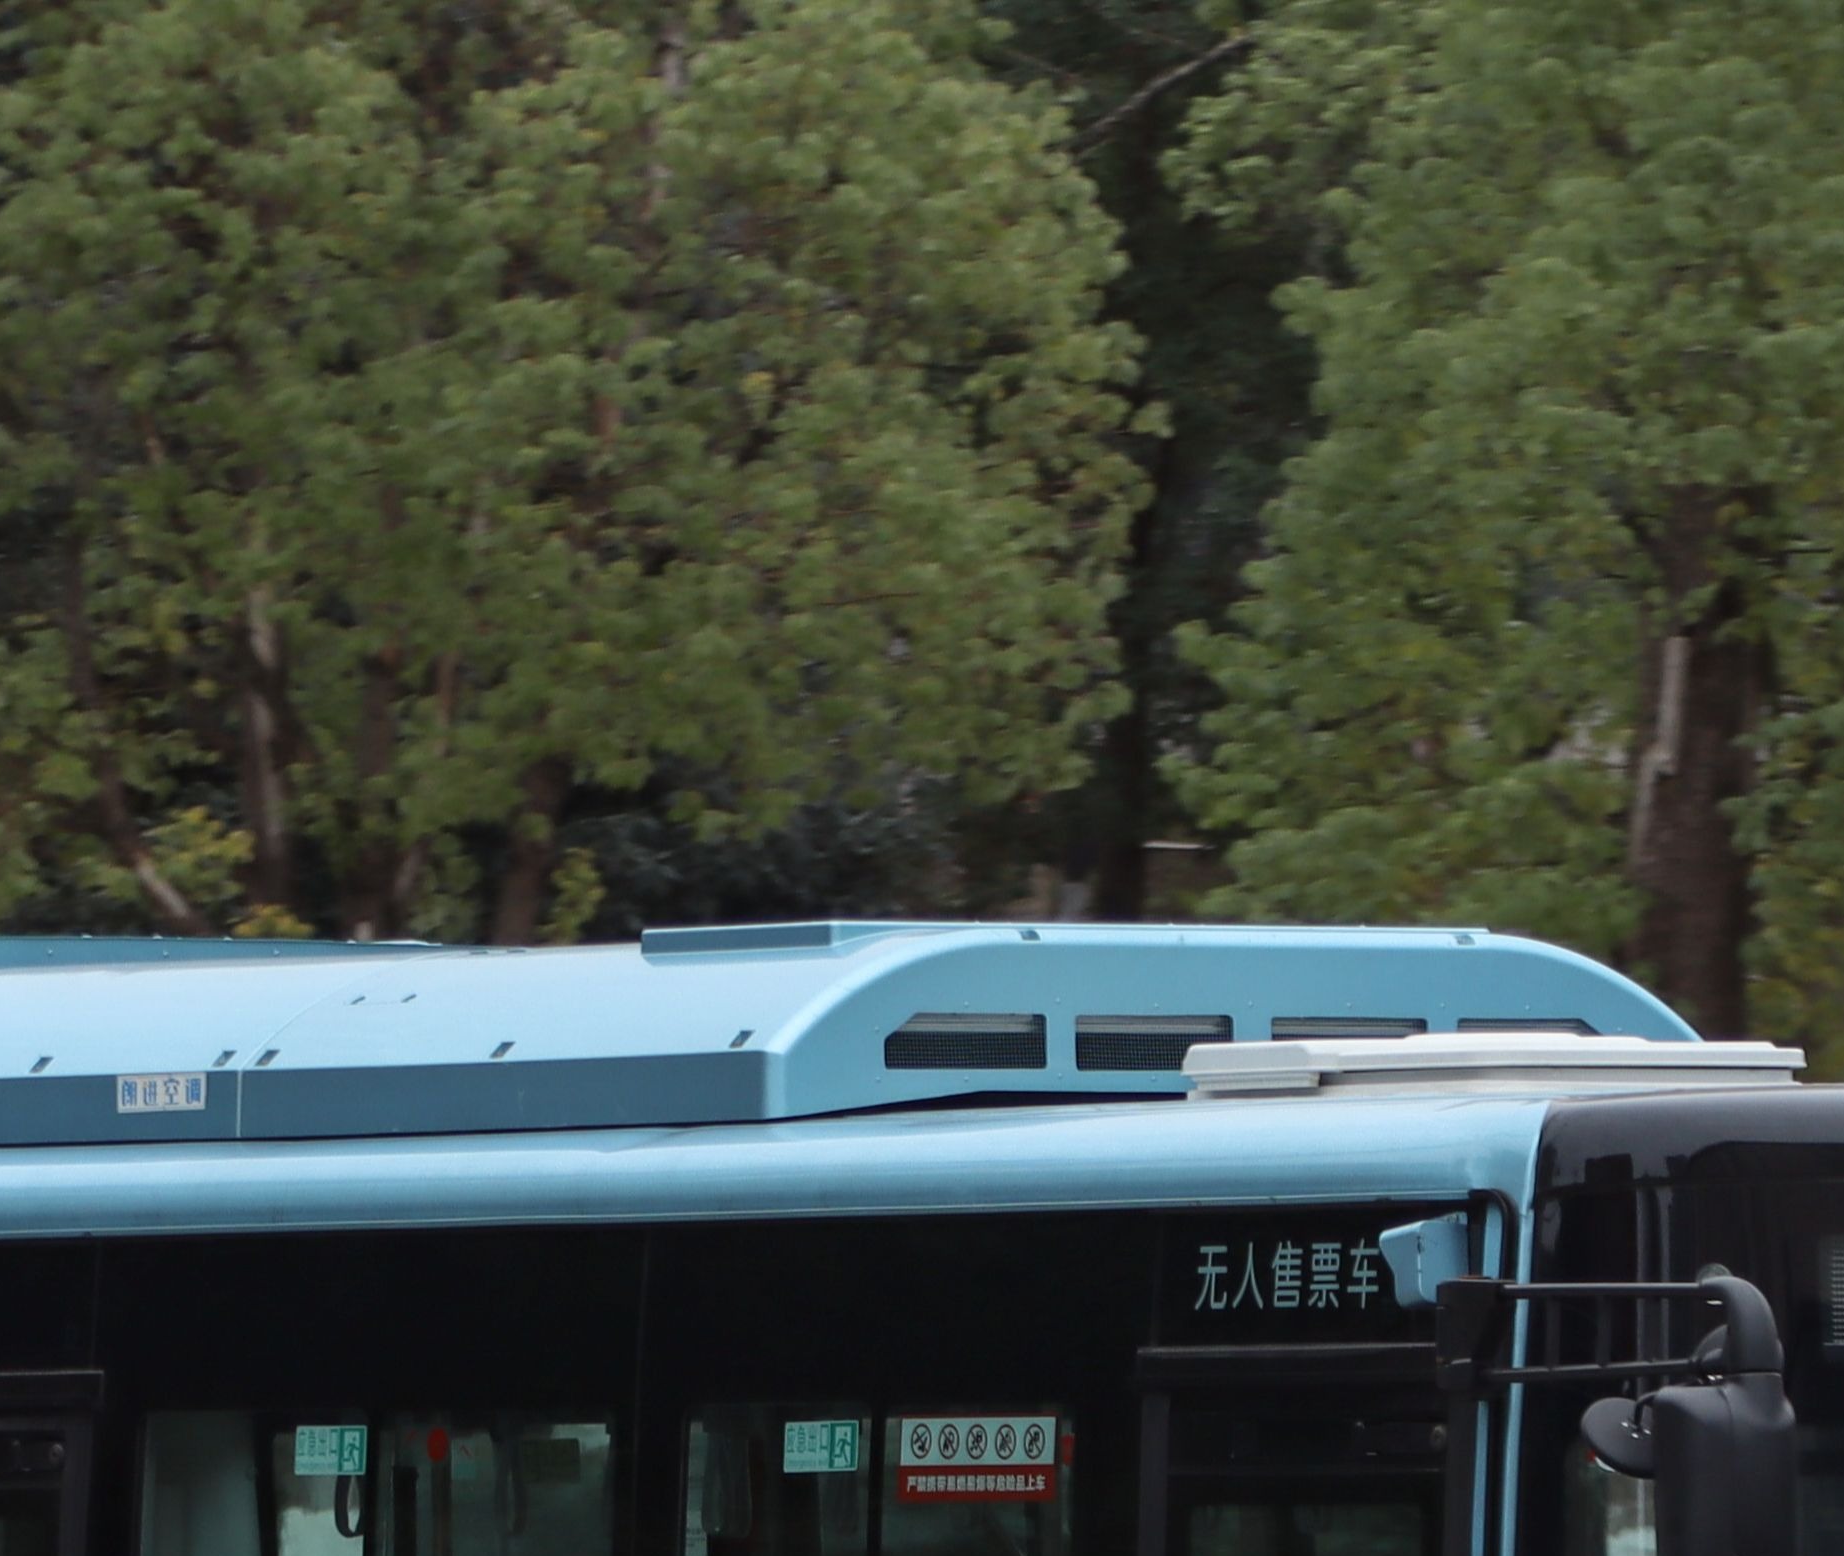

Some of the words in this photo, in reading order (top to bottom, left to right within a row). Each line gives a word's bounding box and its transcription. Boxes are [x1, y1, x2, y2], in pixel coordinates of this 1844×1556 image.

[1195, 1237, 1380, 1310] 无人售票车
